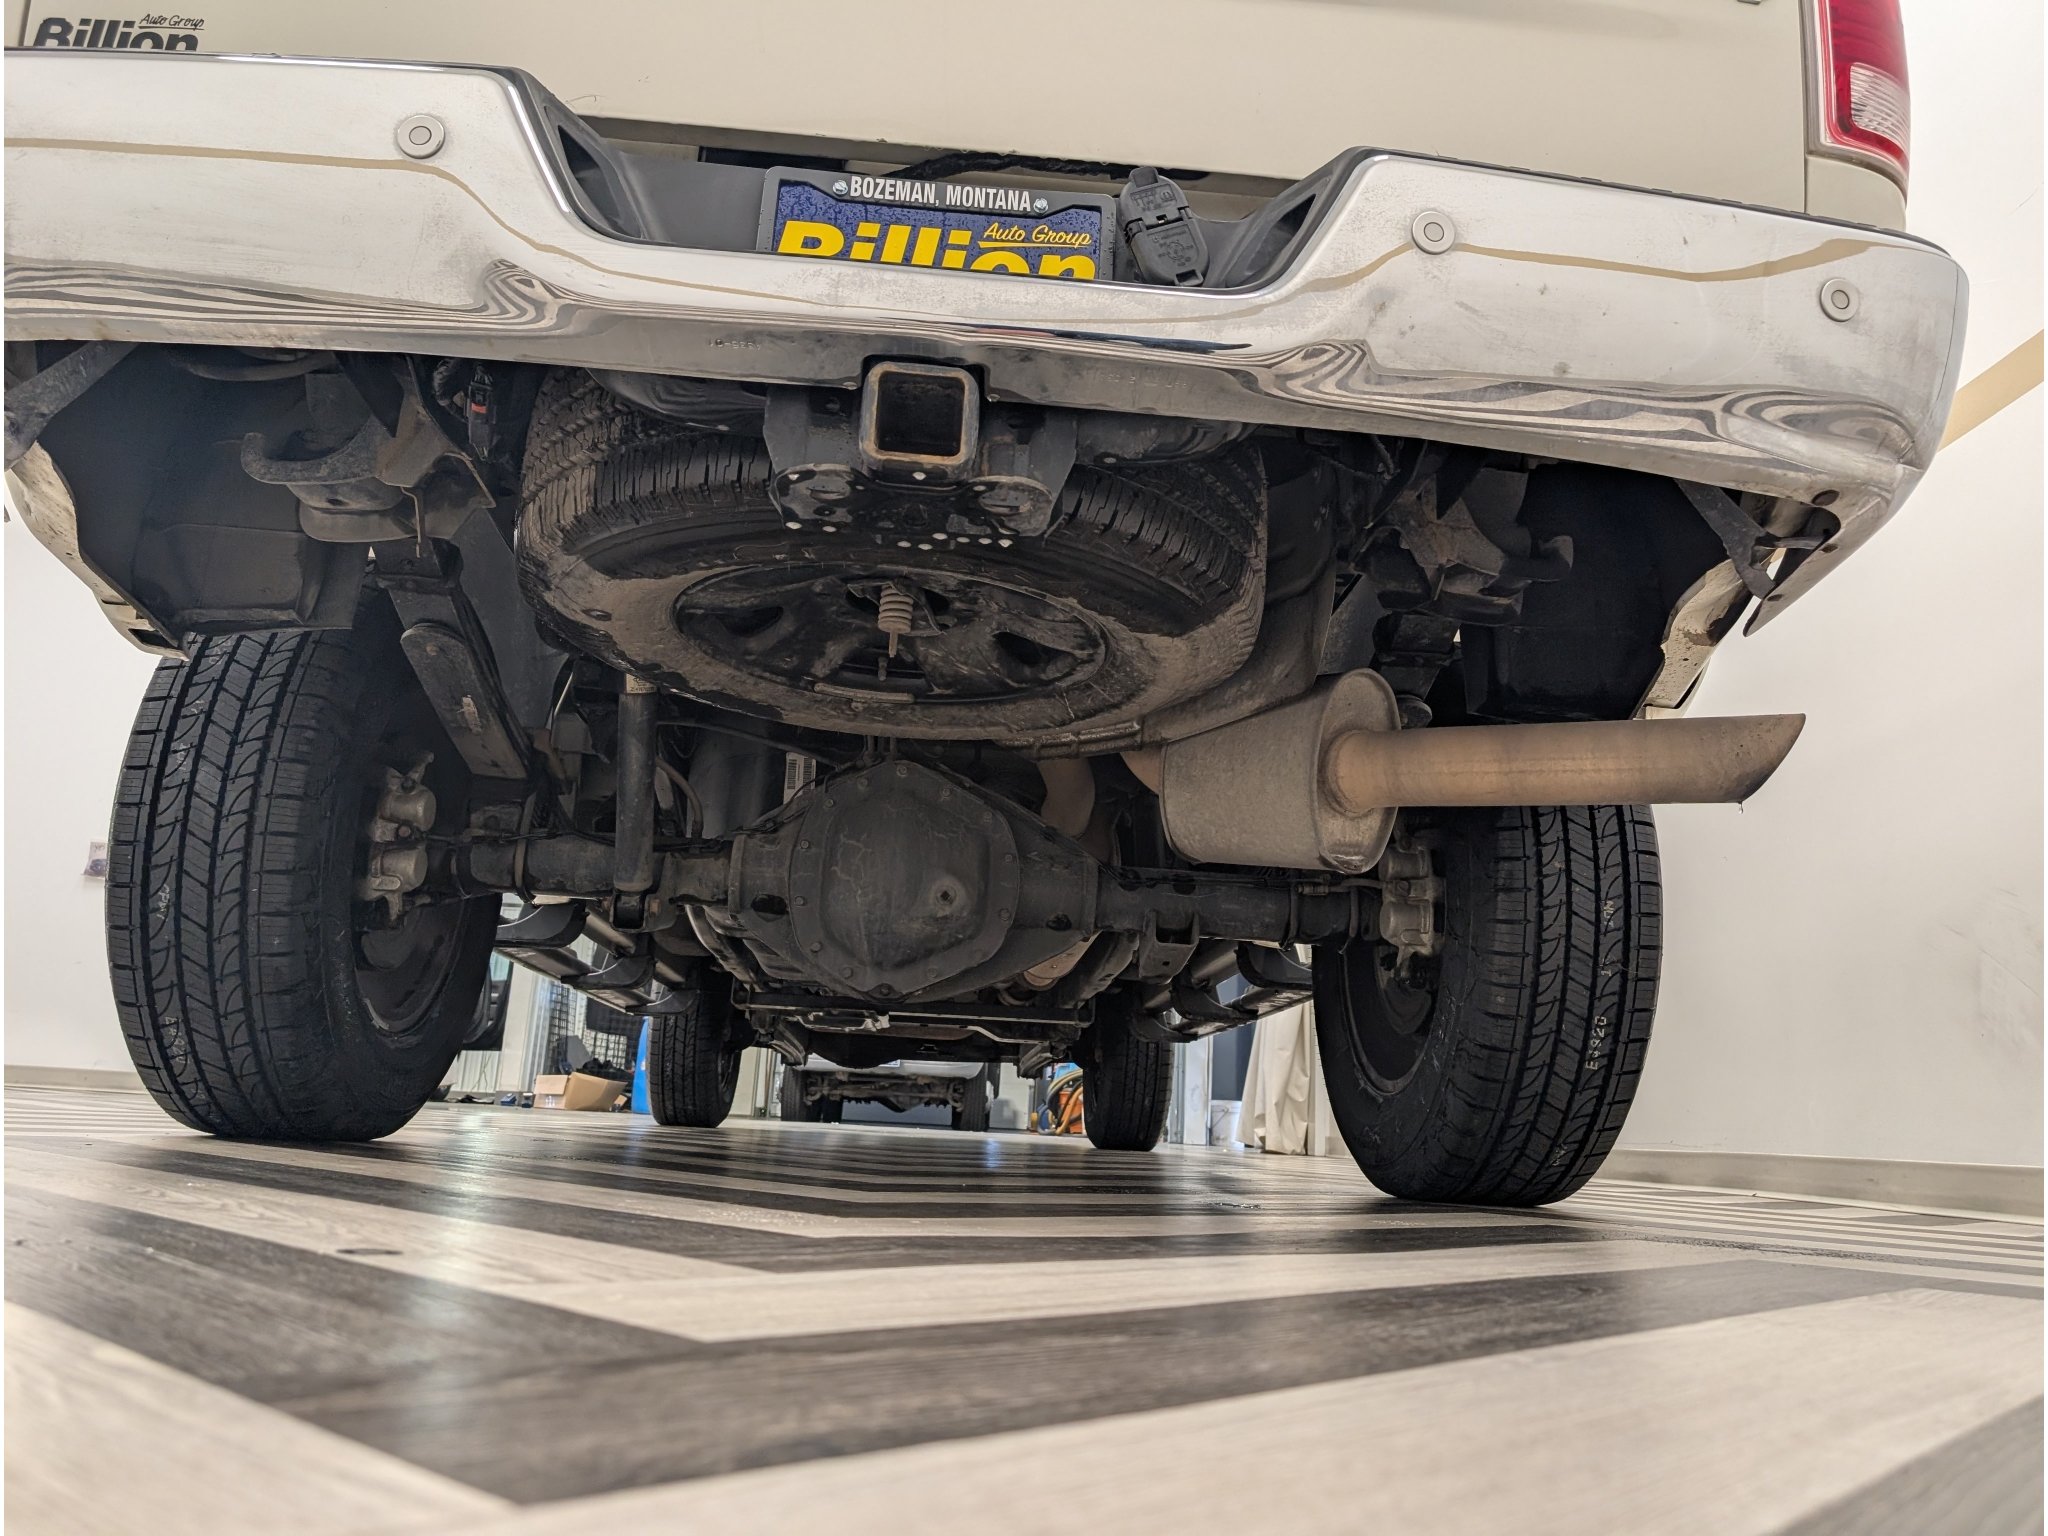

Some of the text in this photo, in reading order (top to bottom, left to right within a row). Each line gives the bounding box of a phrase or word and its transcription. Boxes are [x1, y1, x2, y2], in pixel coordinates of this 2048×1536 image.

[33, 17, 199, 51] Billion
[139, 13, 205, 31] Auto Group
[850, 175, 1031, 212] BOZEMAN, MONTANA
[983, 222, 1091, 249] Auto Group
